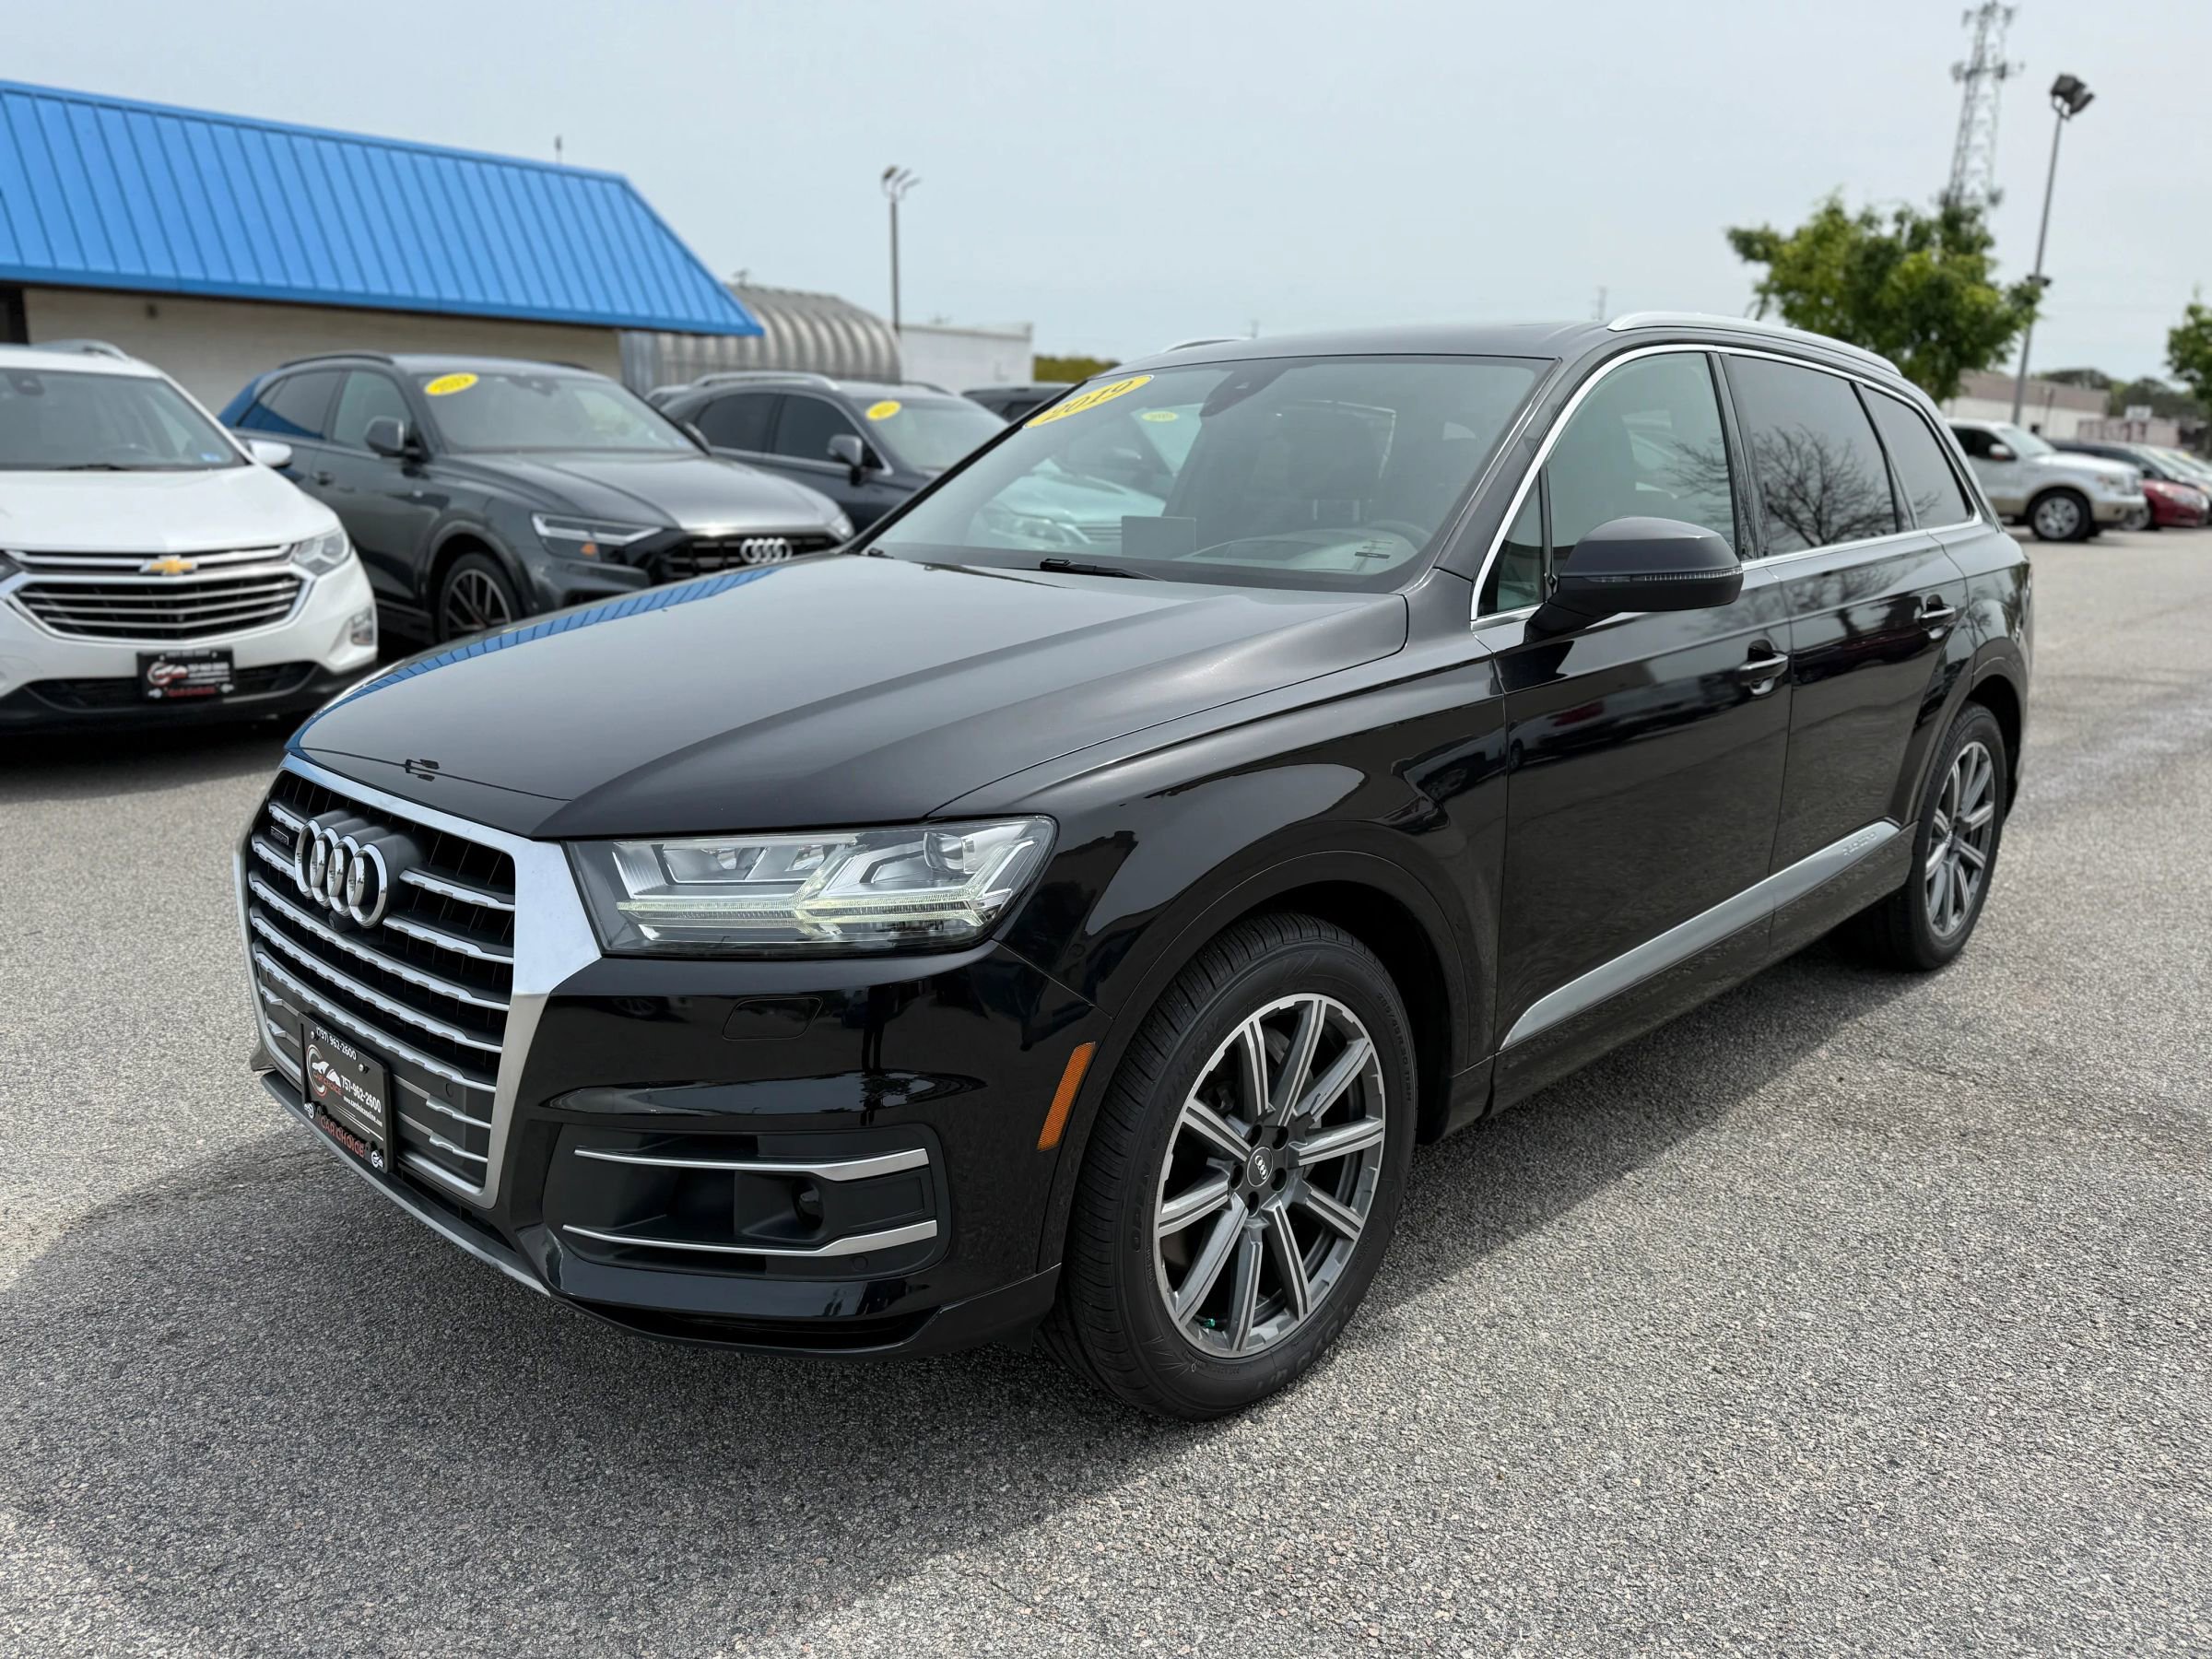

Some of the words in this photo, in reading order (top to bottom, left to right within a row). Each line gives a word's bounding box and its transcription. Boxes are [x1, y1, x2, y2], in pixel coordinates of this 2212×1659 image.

[1041, 380, 1135, 423] 2019
[329, 1034, 357, 1061] 962-2600
[323, 1077, 344, 1098] CHOICE
[340, 1075, 382, 1113] 757-962-2600
[320, 1114, 335, 1136] CAR
[335, 1126, 365, 1159] CHOICE
